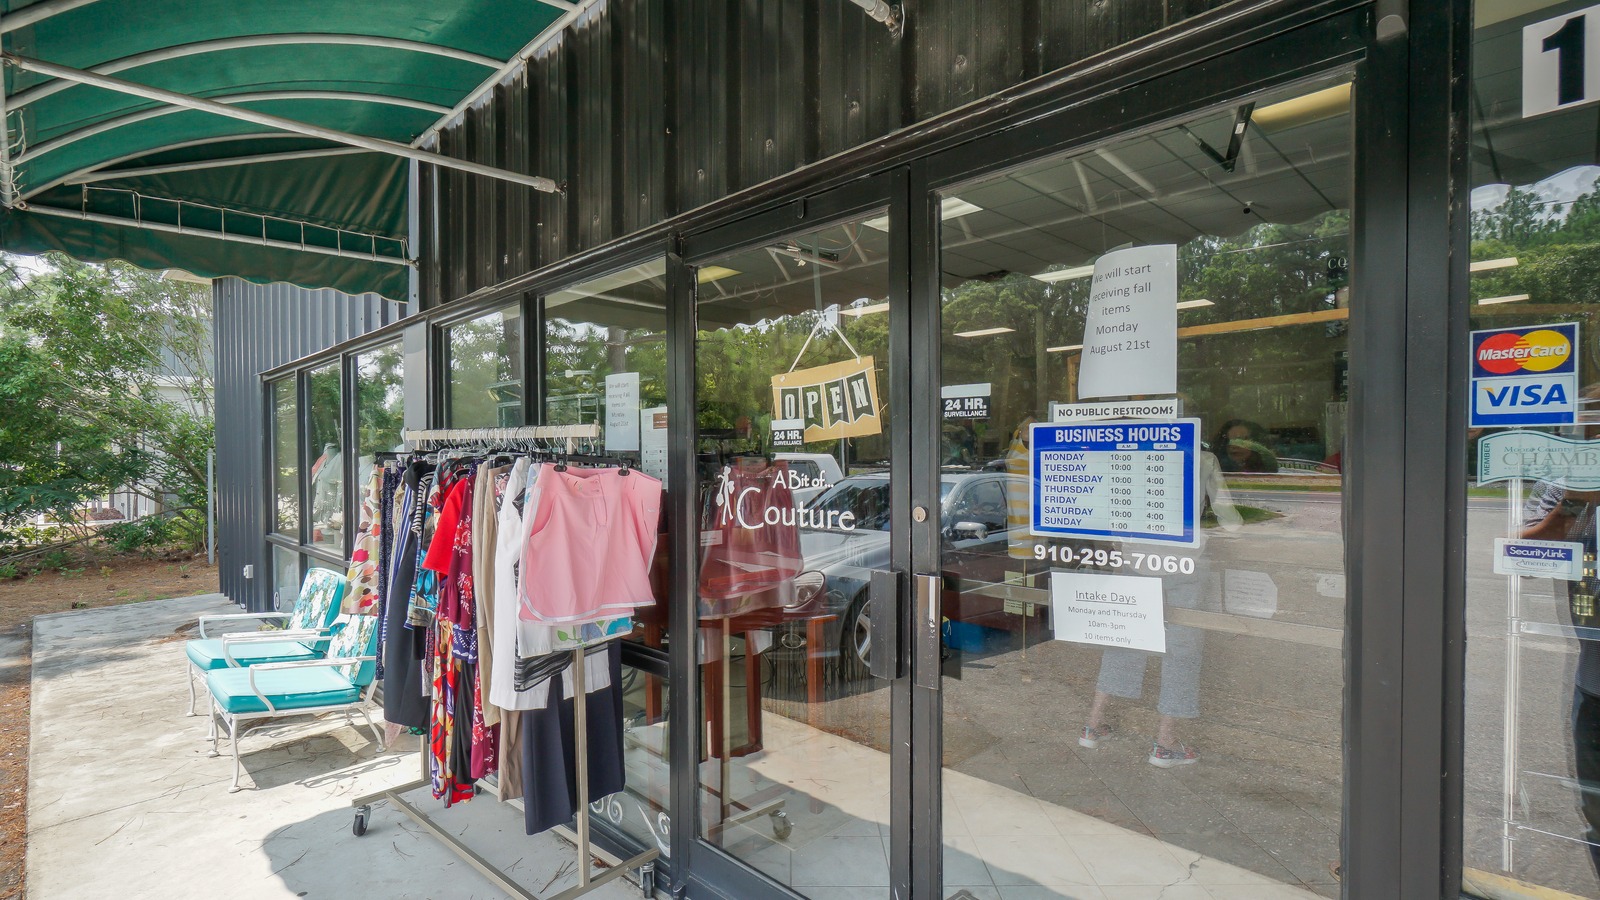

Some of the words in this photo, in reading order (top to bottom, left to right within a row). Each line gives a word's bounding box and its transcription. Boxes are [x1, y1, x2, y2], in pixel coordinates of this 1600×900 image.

[1542, 14, 1587, 106] 1
[1094, 273, 1103, 284] We
[1105, 267, 1121, 280] will
[1124, 264, 1152, 277] start
[1092, 286, 1130, 302] receiving
[1133, 282, 1151, 294] fall
[1102, 304, 1131, 316] items
[1096, 322, 1139, 335] Monday
[1090, 343, 1122, 356] August
[1126, 339, 1151, 351] 21st
[1479, 343, 1568, 361] MasterCard
[784, 378, 869, 420] OPEN
[1481, 383, 1568, 407] VISA
[945, 399, 961, 411] 24
[964, 398, 987, 410] HR.
[1058, 408, 1073, 417] NO
[1075, 407, 1110, 417] PUBLIC
[1112, 405, 1174, 416] RESTROOMS
[774, 430, 785, 440] 24
[786, 430, 802, 440] HR.
[1055, 428, 1124, 443] BUSINESS
[1128, 427, 1181, 442] HOURS
[1044, 453, 1085, 461] MONDAY
[1110, 454, 1132, 462] 10:00
[1146, 454, 1165, 462] 4:00
[1483, 442, 1491, 476] MEMBER
[1044, 464, 1087, 472] TUESDAY
[1110, 463, 1132, 471] 10:00
[1146, 465, 1164, 473] 4:00
[772, 470, 787, 489] A
[787, 469, 810, 490] Bit
[1044, 475, 1103, 483] WEDNESDAY
[1111, 476, 1132, 484] 10:00
[1146, 477, 1164, 485] 4:00
[1044, 485, 1095, 494] THURSDAY
[1110, 488, 1132, 496] 10:00
[736, 486, 856, 531] Couture
[1044, 496, 1078, 504] FRIDAY
[1110, 498, 1132, 506] 10:00
[1146, 501, 1165, 509] 4:00
[1044, 506, 1094, 516] SATURDAY
[1146, 513, 1164, 521] 4:00
[1044, 517, 1082, 526] SUNDAY
[1110, 522, 1128, 530] 1:00
[1146, 524, 1165, 532] 4:00
[1033, 544, 1195, 575] 910-295-7060
[1509, 546, 1567, 559] SecurityLink
[1075, 590, 1107, 601] Intake
[1110, 592, 1137, 604] Days
[1068, 606, 1096, 616] Monday
[1097, 608, 1111, 616] and
[1112, 609, 1147, 620] Thursday
[1088, 620, 1126, 630] 10am-3pm
[1084, 632, 1093, 640] 10
[1094, 633, 1114, 642] items
[1115, 636, 1132, 645] only
